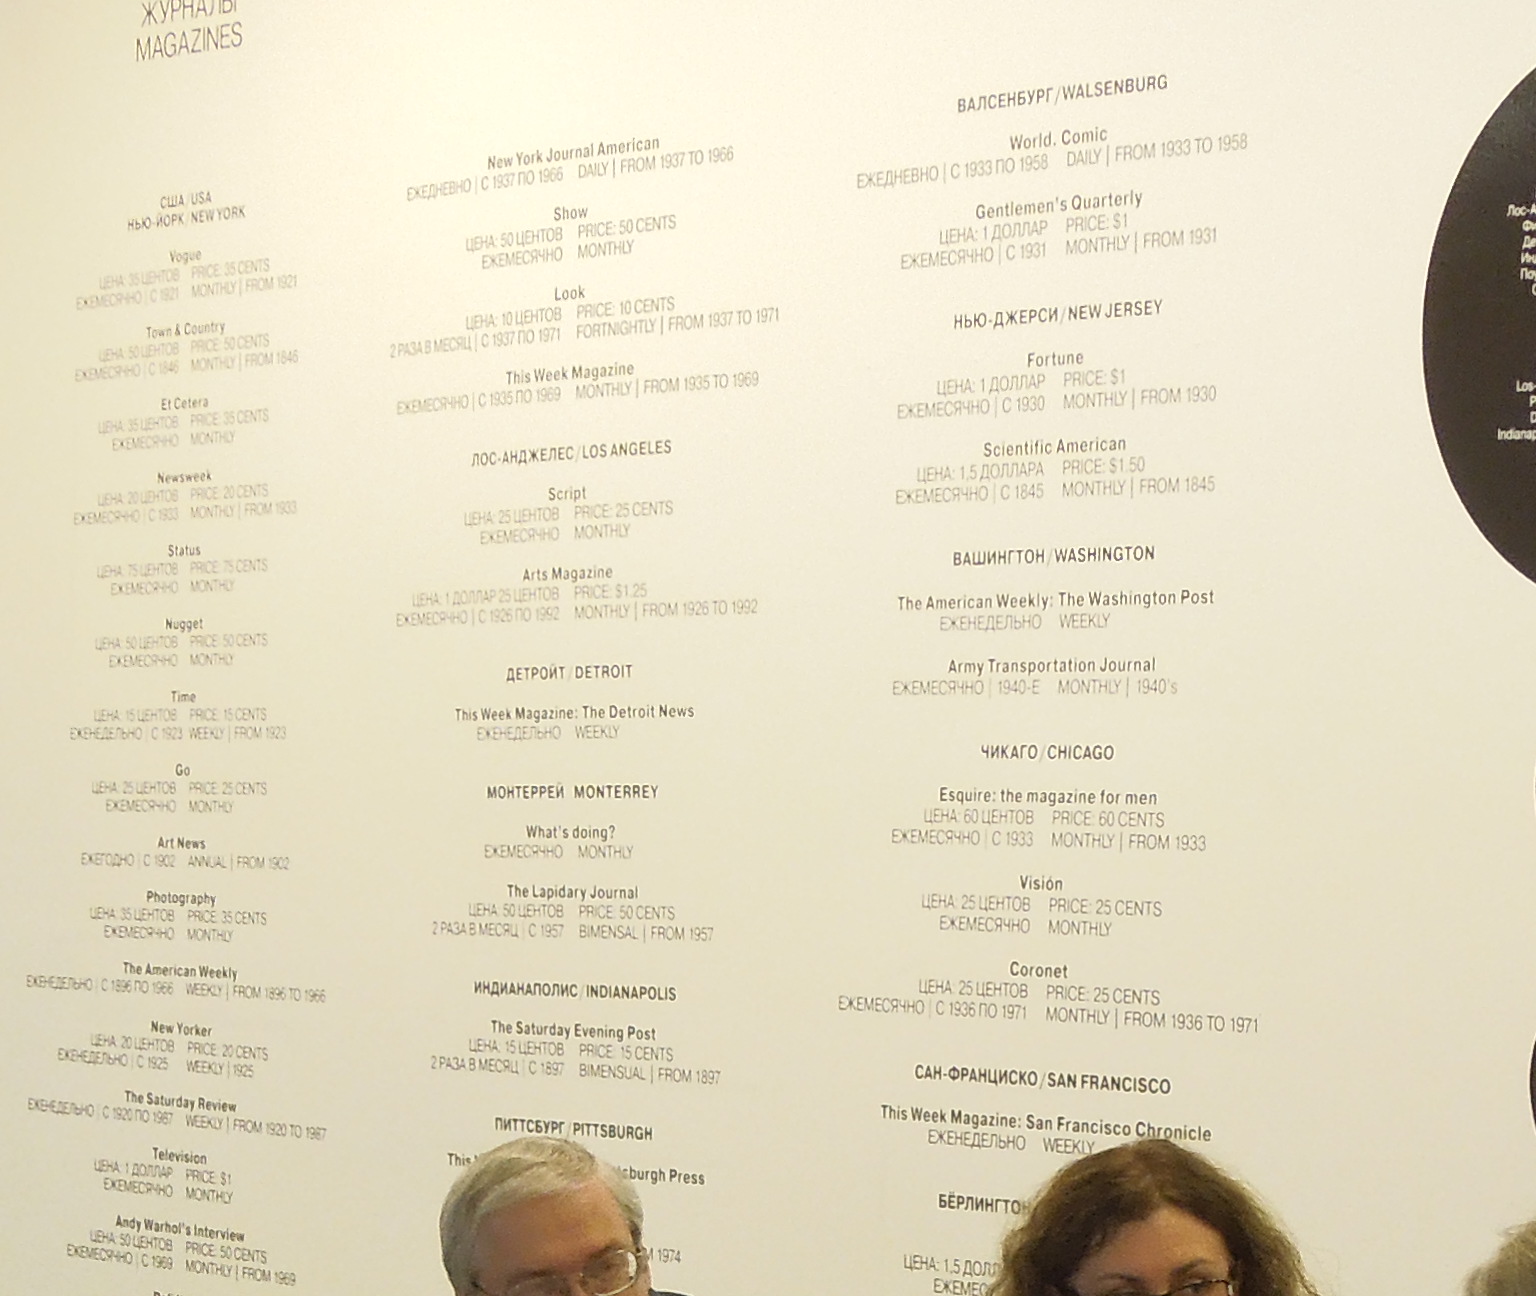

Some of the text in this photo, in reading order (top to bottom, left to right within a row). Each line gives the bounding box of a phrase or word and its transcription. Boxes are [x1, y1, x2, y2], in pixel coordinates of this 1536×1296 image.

[135, 20, 243, 62] MAGAZINES
[1061, 125, 1107, 146] Comic
[487, 136, 659, 170] New York Journal American
[1070, 189, 1142, 210] Quarterly
[553, 205, 588, 221] Show
[169, 249, 201, 265] Vogue
[553, 283, 585, 301] Look
[1104, 299, 1163, 319] JERSEY
[145, 320, 225, 339] Town & Country
[1027, 351, 1083, 368] Fortune
[505, 361, 634, 385] This Week Magazine
[983, 436, 1126, 457] Scientific American
[156, 470, 211, 484] Newsweek
[547, 485, 586, 503] Script
[167, 543, 201, 558] Status
[522, 566, 613, 583] Arts Magazine
[897, 588, 1214, 611] The American Weekly: The Washington Post
[947, 655, 1155, 677] Army Transportation Journal
[170, 689, 196, 703] Time
[486, 784, 564, 799] МОНТЕРРЕЙ
[573, 784, 658, 799] MONTERREY
[939, 786, 1157, 807] Esquire: the magazine for men
[571, 824, 615, 842] doing?
[1019, 874, 1063, 891] Visión
[145, 889, 216, 908] Photography
[1009, 960, 1067, 979] Coronet
[150, 1019, 212, 1037] New Yorker
[490, 1018, 655, 1043] The Saturday Evening Post
[151, 1146, 207, 1165] Television
